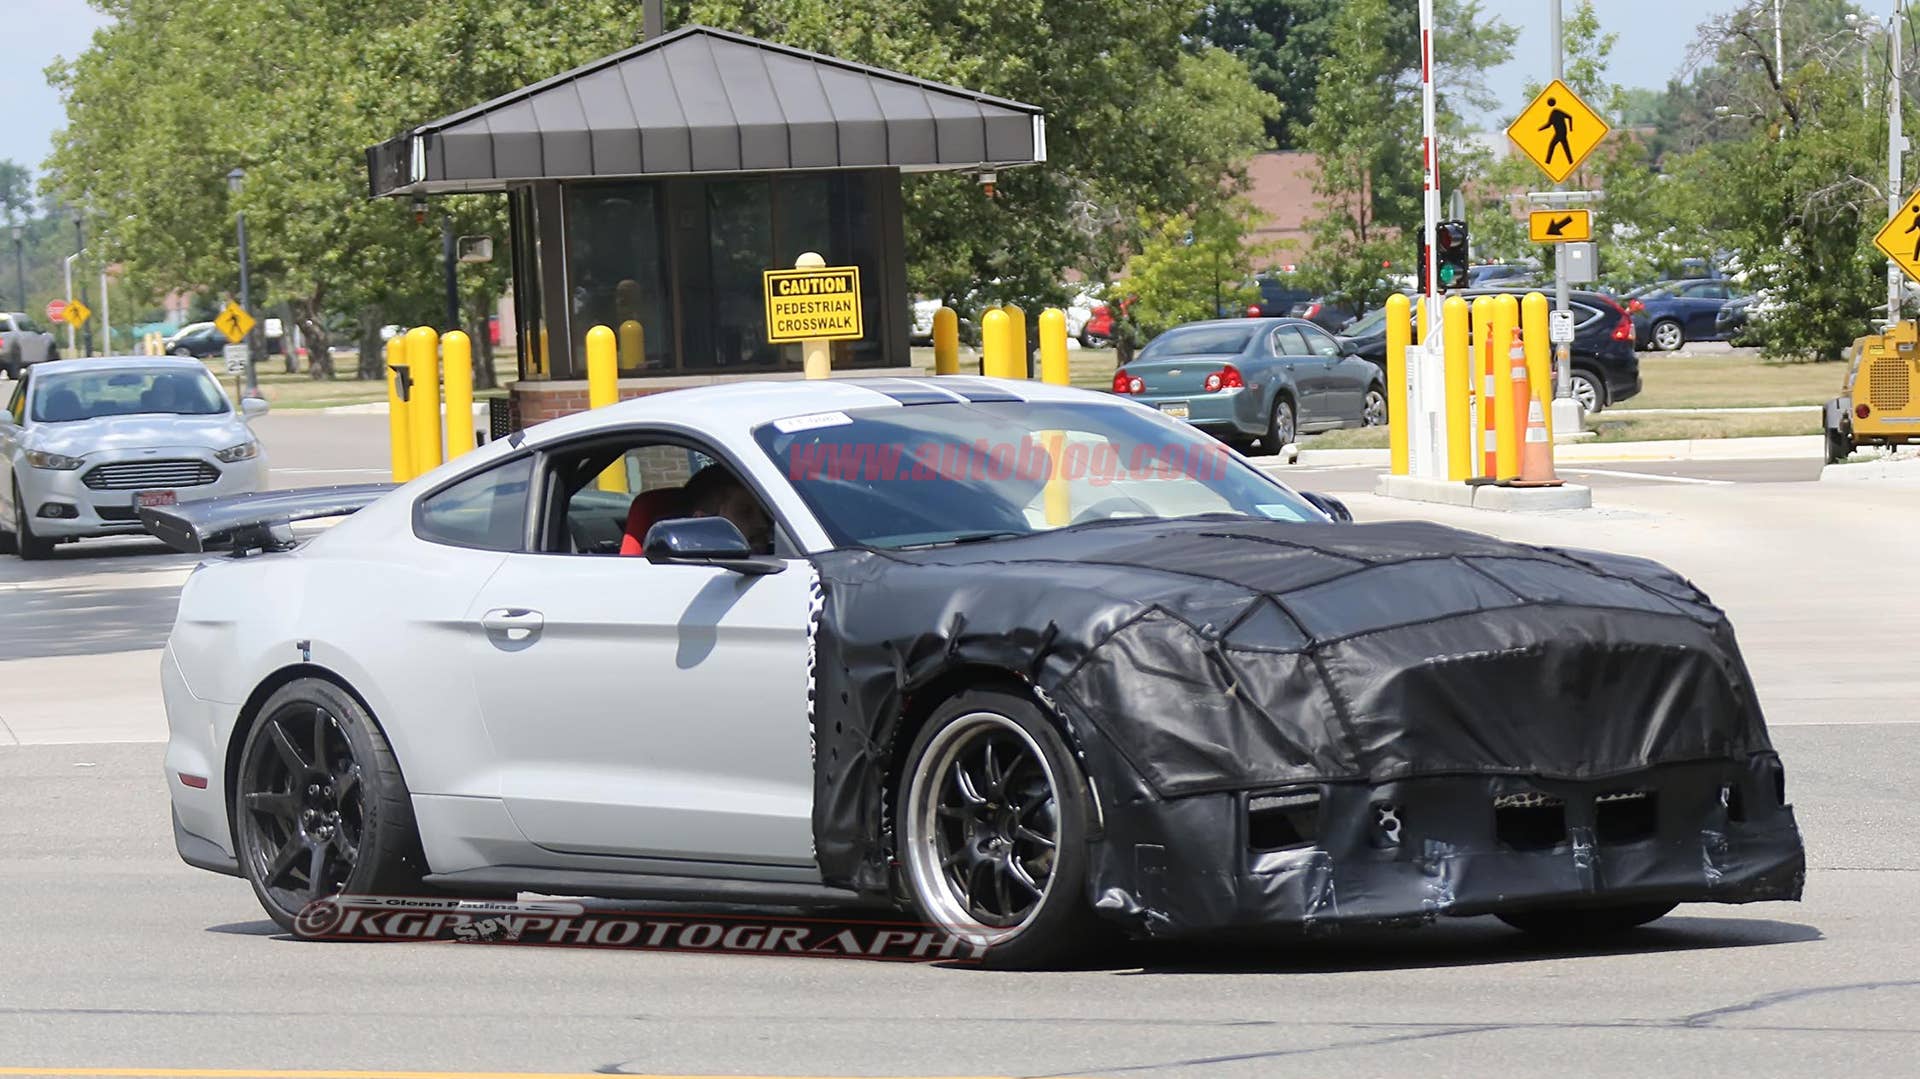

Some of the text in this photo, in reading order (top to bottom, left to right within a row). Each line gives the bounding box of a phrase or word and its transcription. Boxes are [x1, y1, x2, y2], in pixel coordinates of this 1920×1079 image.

[779, 277, 847, 295] CAUTION
[776, 300, 851, 315] PEDESTRIAN
[777, 316, 852, 331] CROSSWALK
